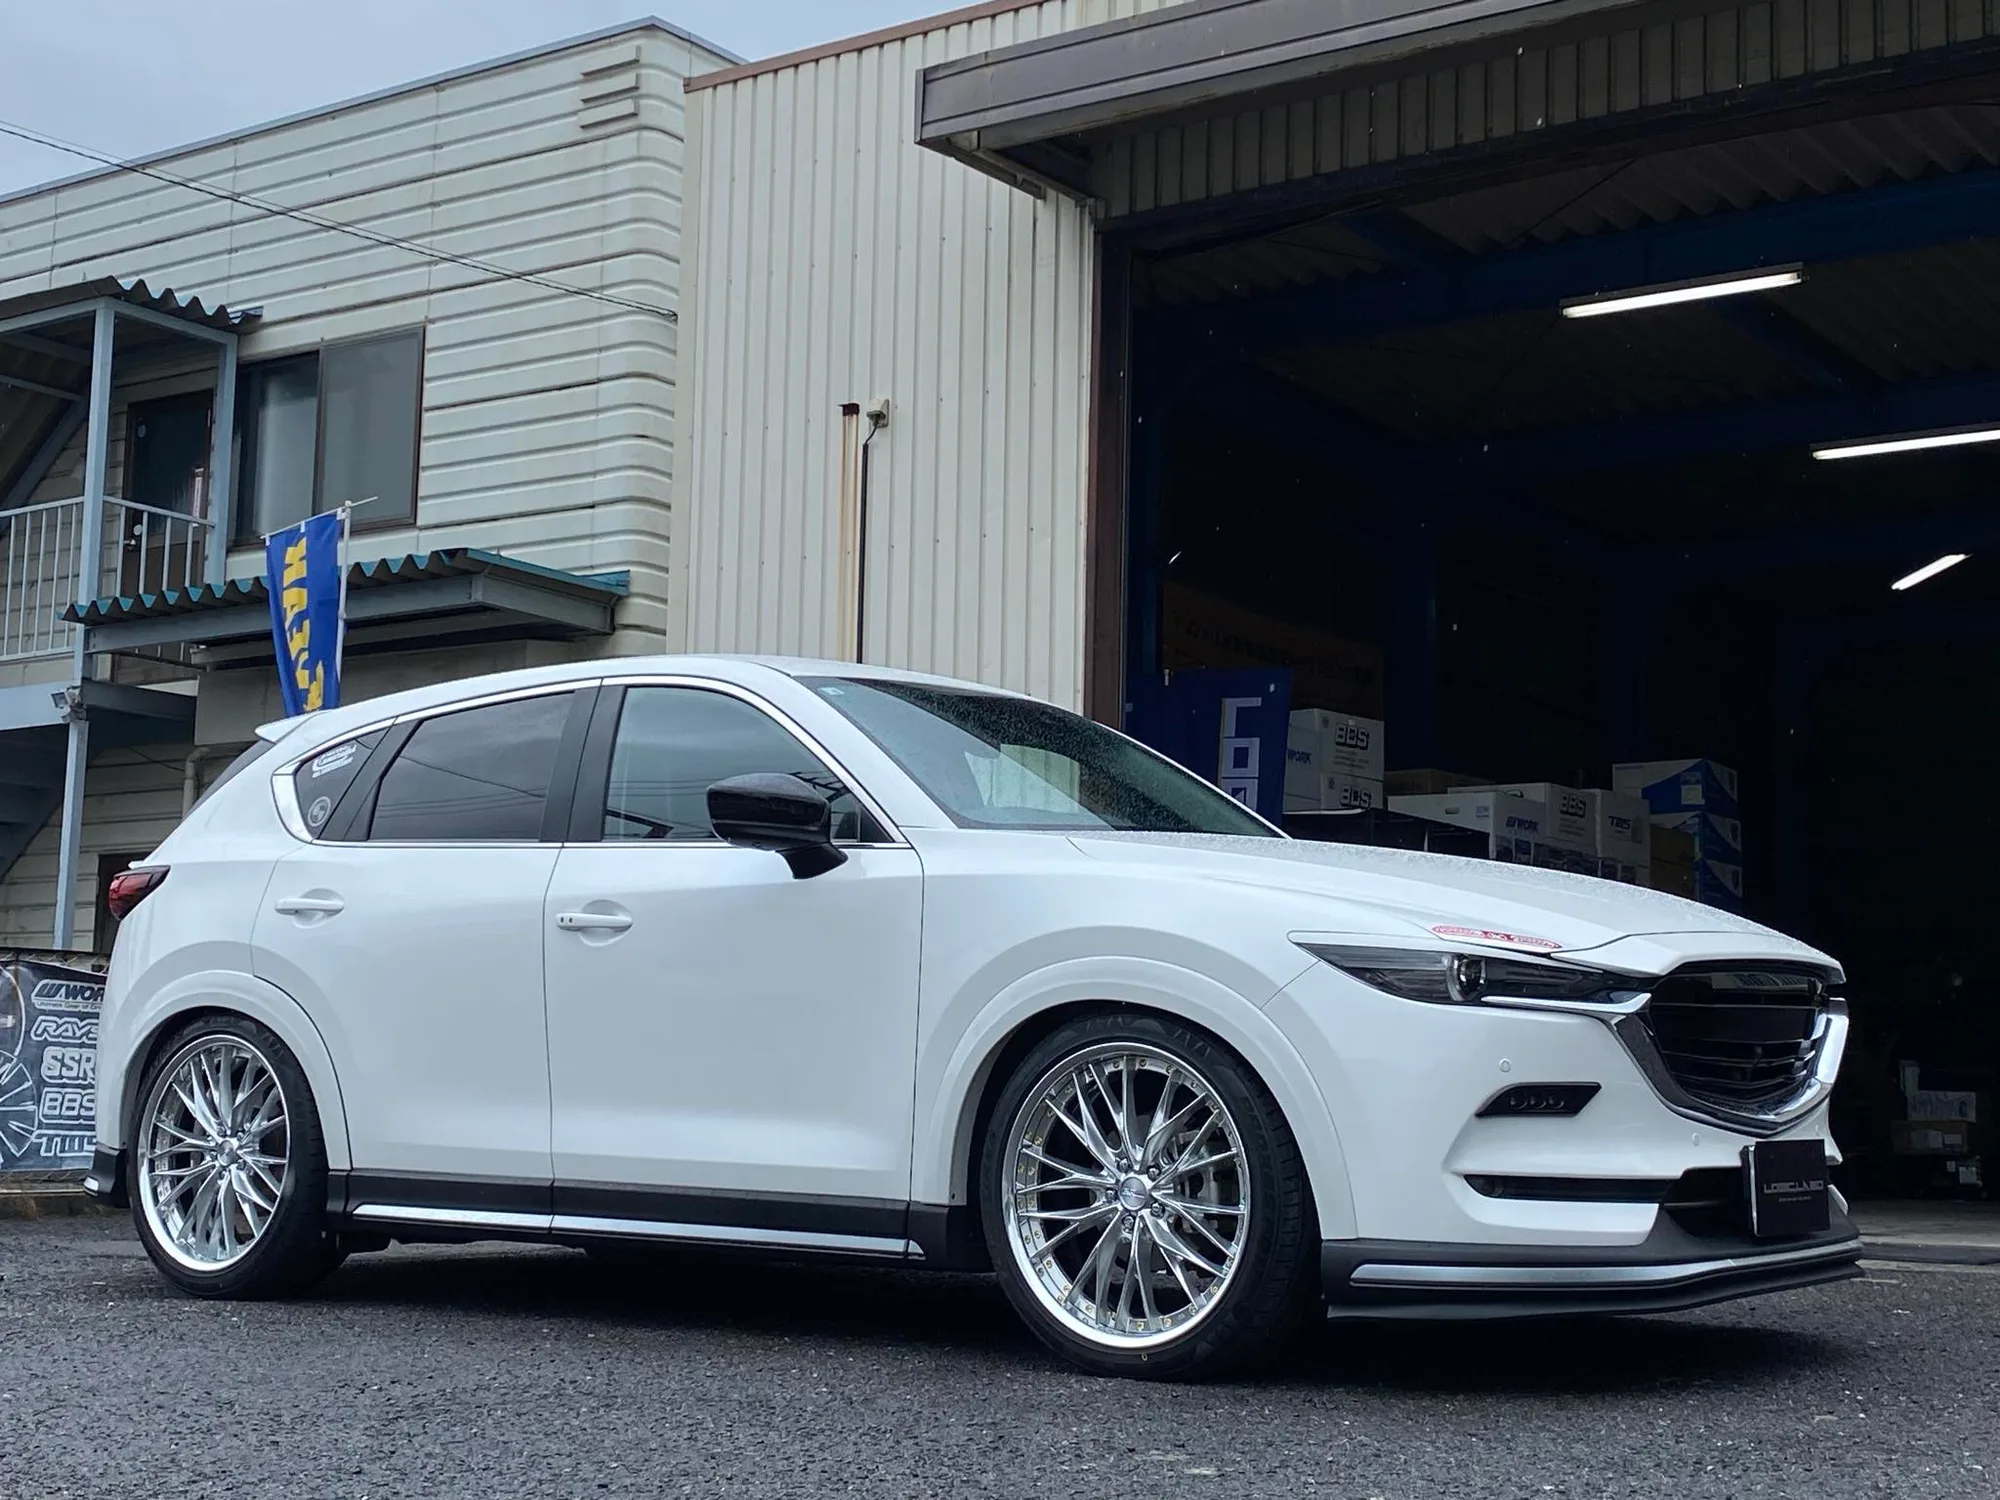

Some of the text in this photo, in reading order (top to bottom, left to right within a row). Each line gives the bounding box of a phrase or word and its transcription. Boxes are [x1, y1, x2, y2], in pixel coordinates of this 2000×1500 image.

[1335, 725, 1369, 750] BBS
[44, 1049, 96, 1079] SSR
[42, 1092, 96, 1116] BBS
